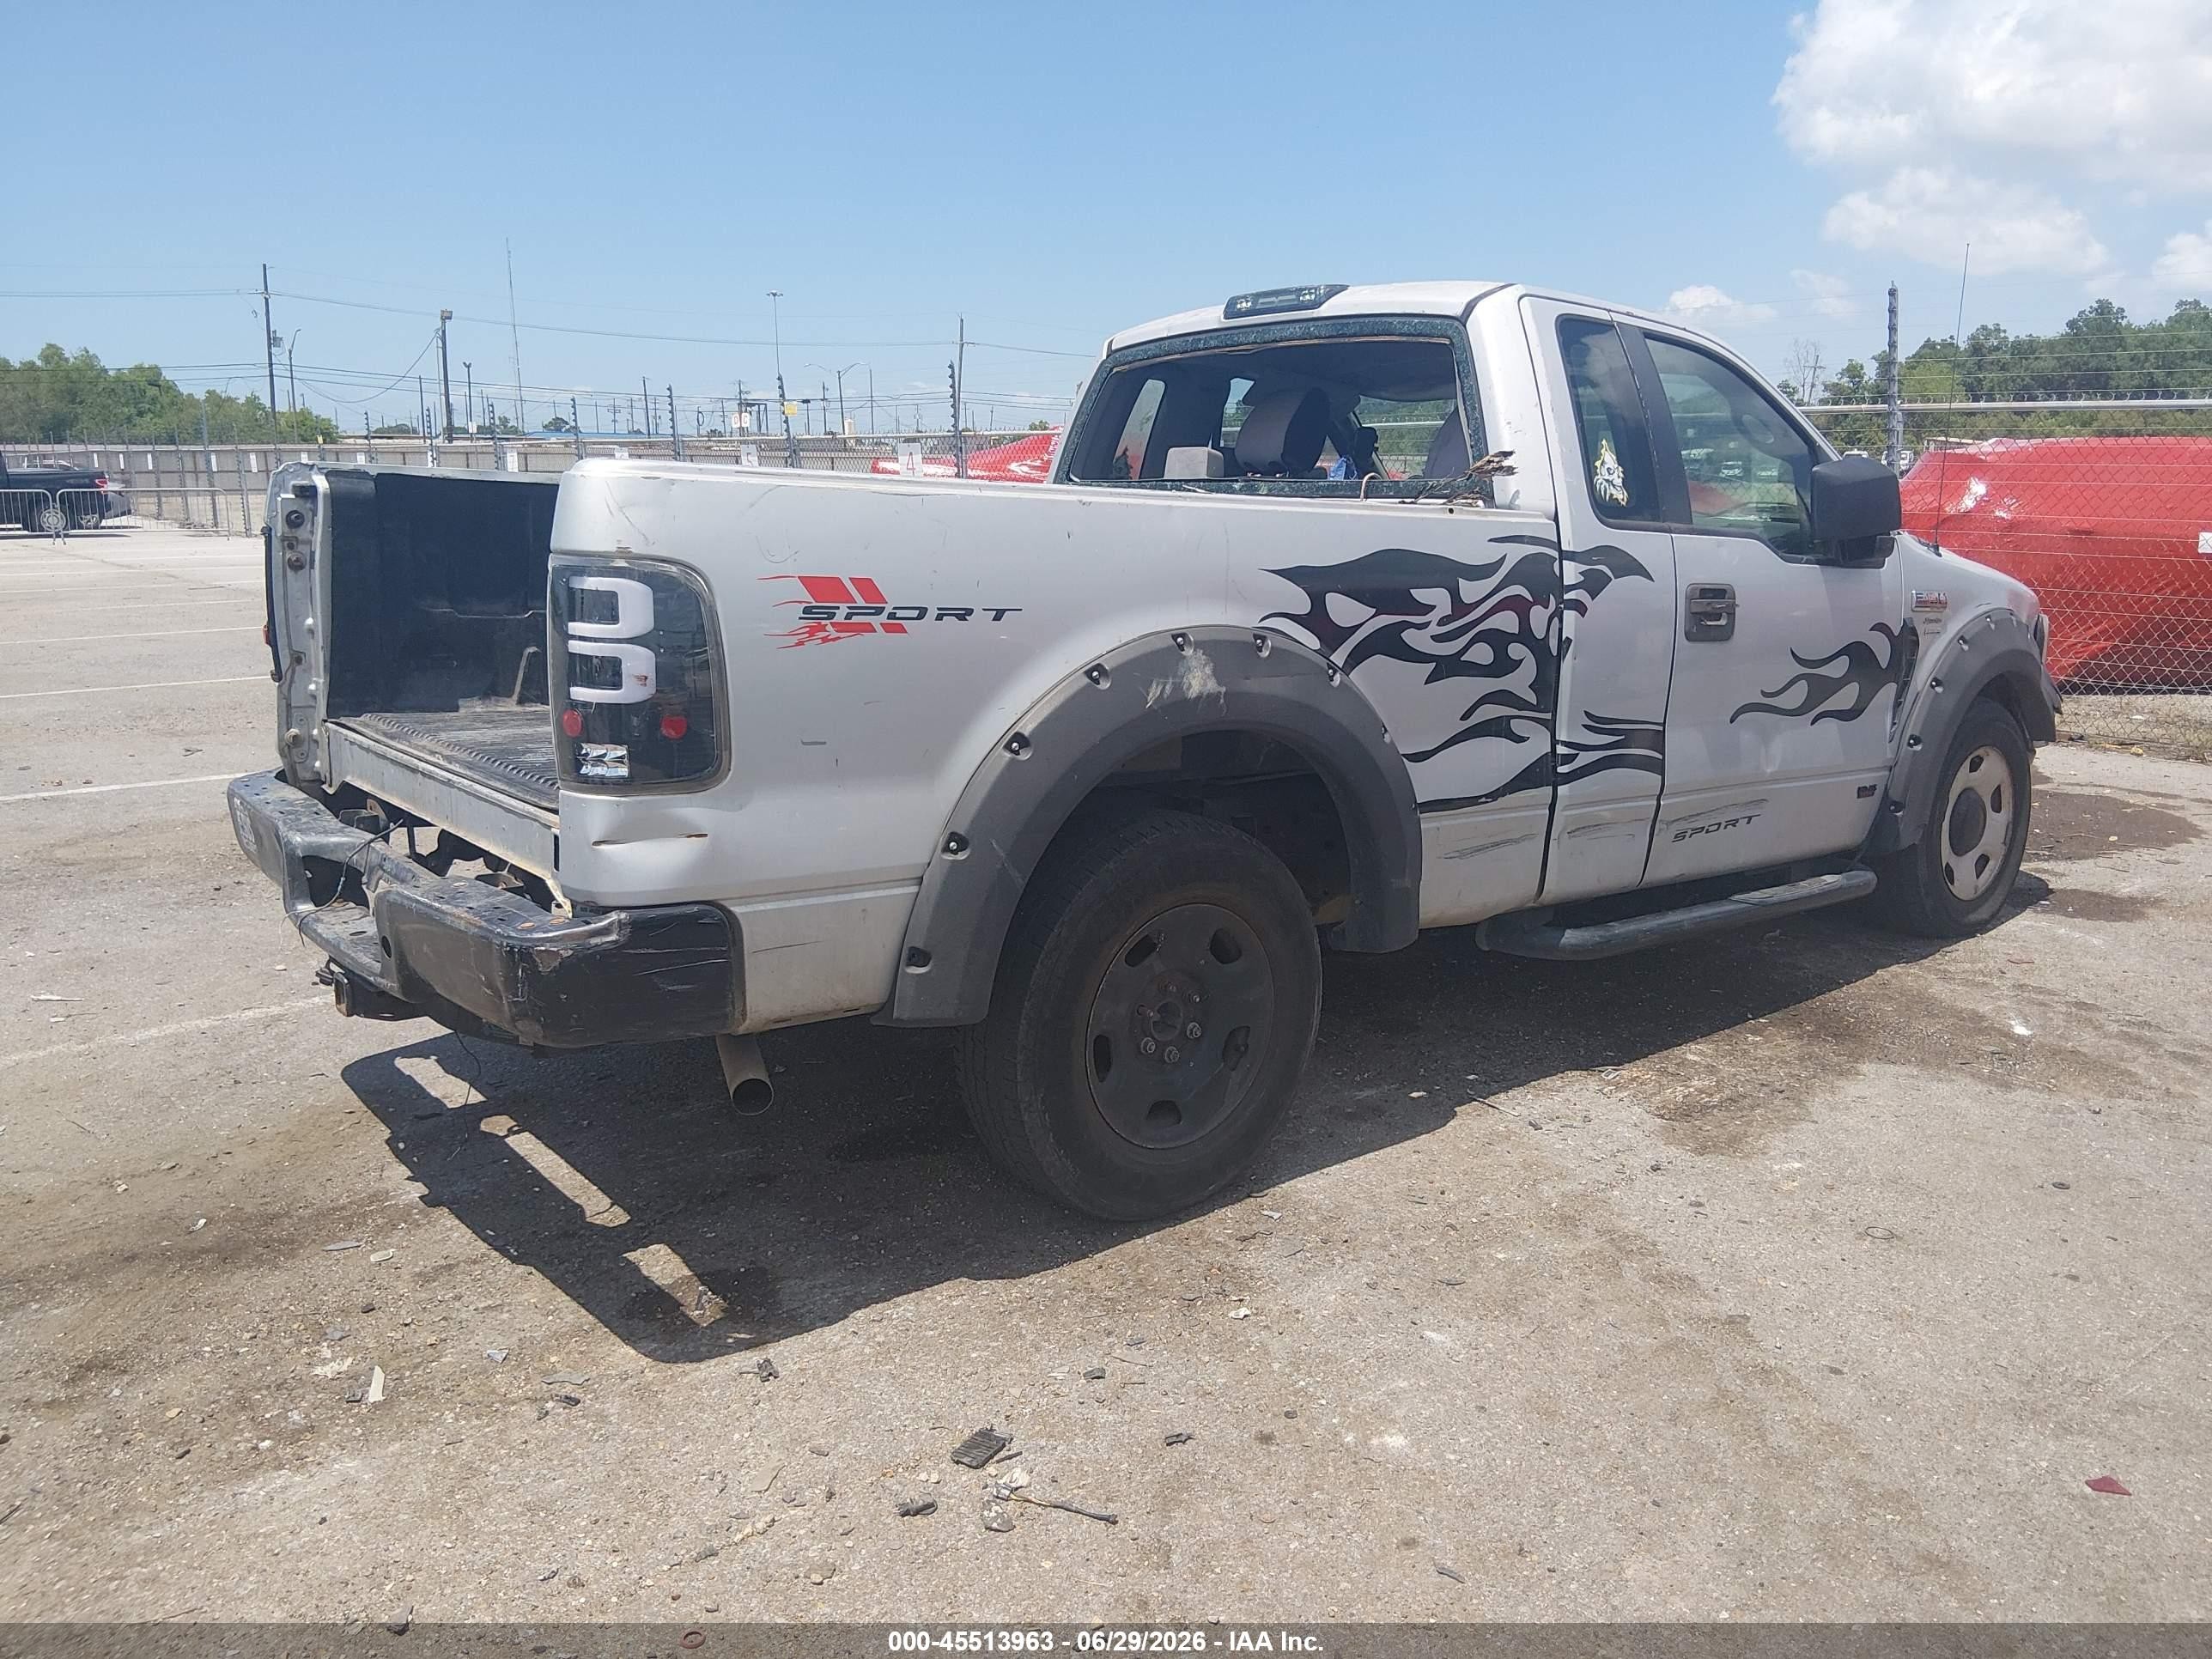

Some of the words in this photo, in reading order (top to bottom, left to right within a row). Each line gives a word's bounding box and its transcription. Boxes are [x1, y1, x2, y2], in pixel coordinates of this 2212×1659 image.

[906, 452, 916, 477] 4
[798, 605, 1024, 622] SPORT
[1672, 813, 1761, 843] SPORT
